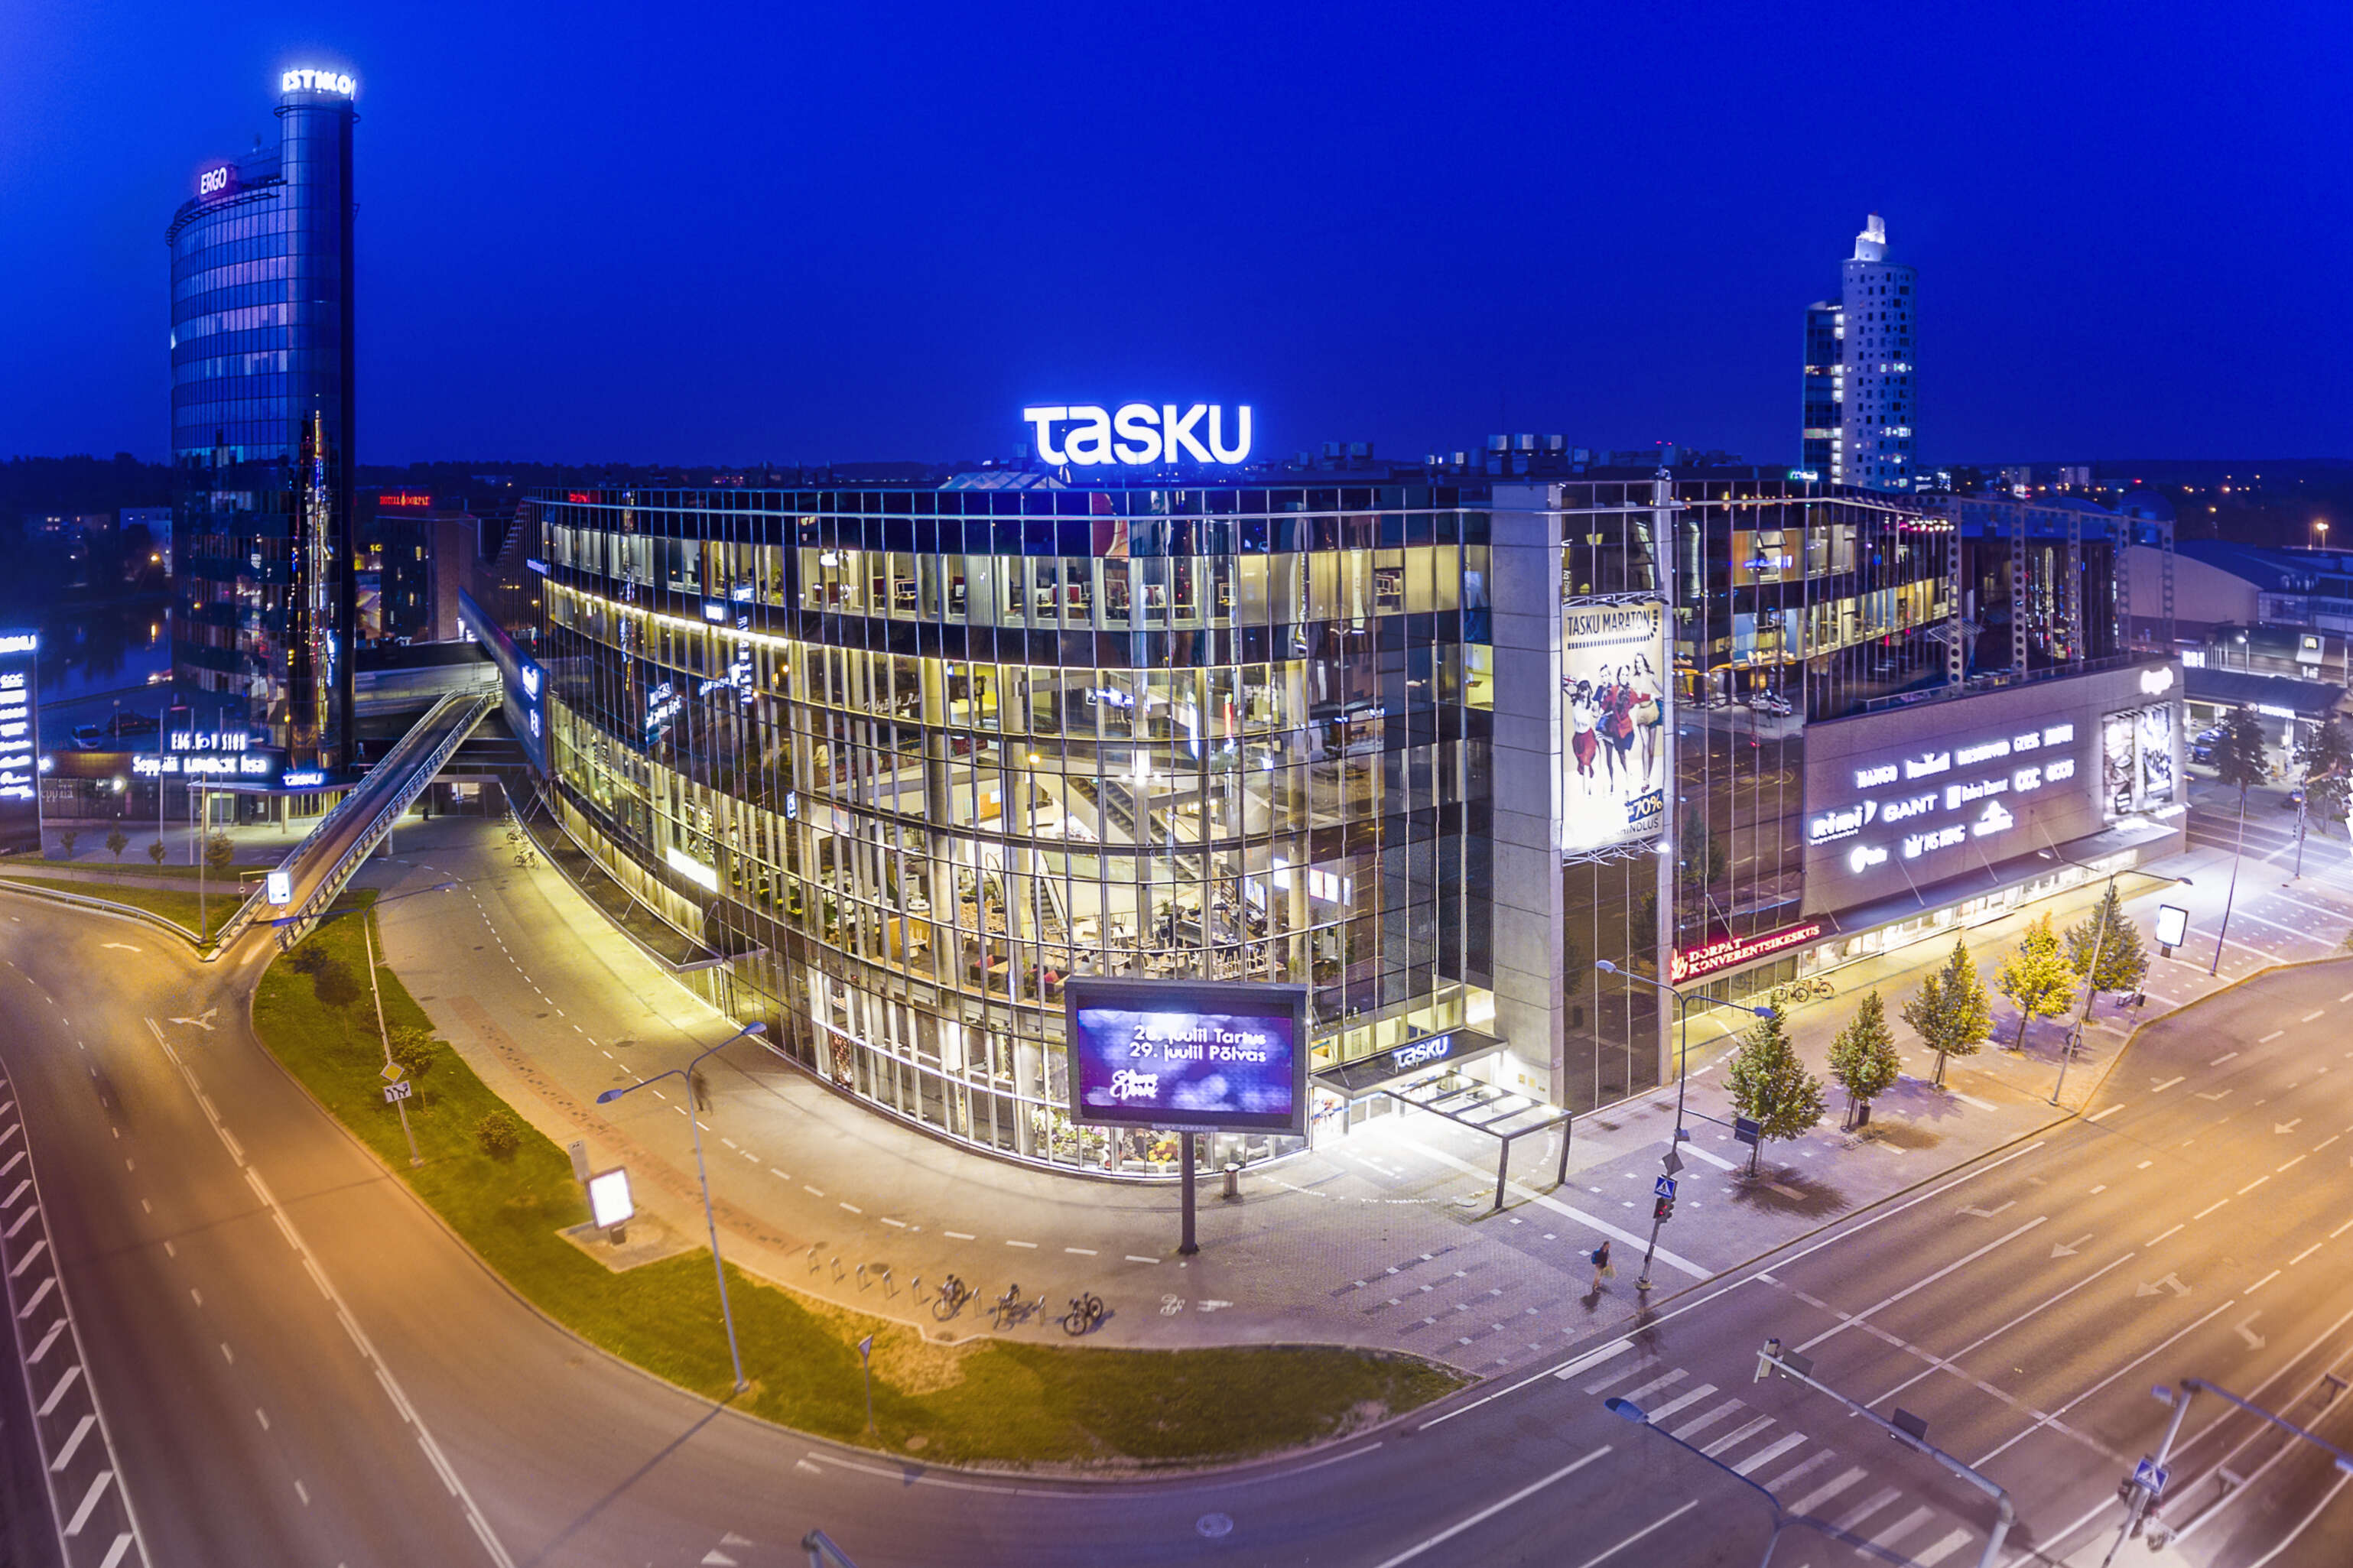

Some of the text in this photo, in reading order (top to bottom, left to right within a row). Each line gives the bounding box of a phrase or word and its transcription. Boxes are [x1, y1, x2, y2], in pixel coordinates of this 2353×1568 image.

[200, 167, 227, 194] ERGO
[1568, 610, 1650, 637] TASKU MARATON
[1883, 794, 1939, 823] GANT
[1688, 937, 1744, 963] DORPAT
[1688, 925, 1821, 975] KONVERENTSIKESKUS
[1168, 1027, 1207, 1044] juulil
[1213, 1028, 1266, 1045] Tartus
[1129, 1041, 1266, 1063] 29. juulil Põlvas
